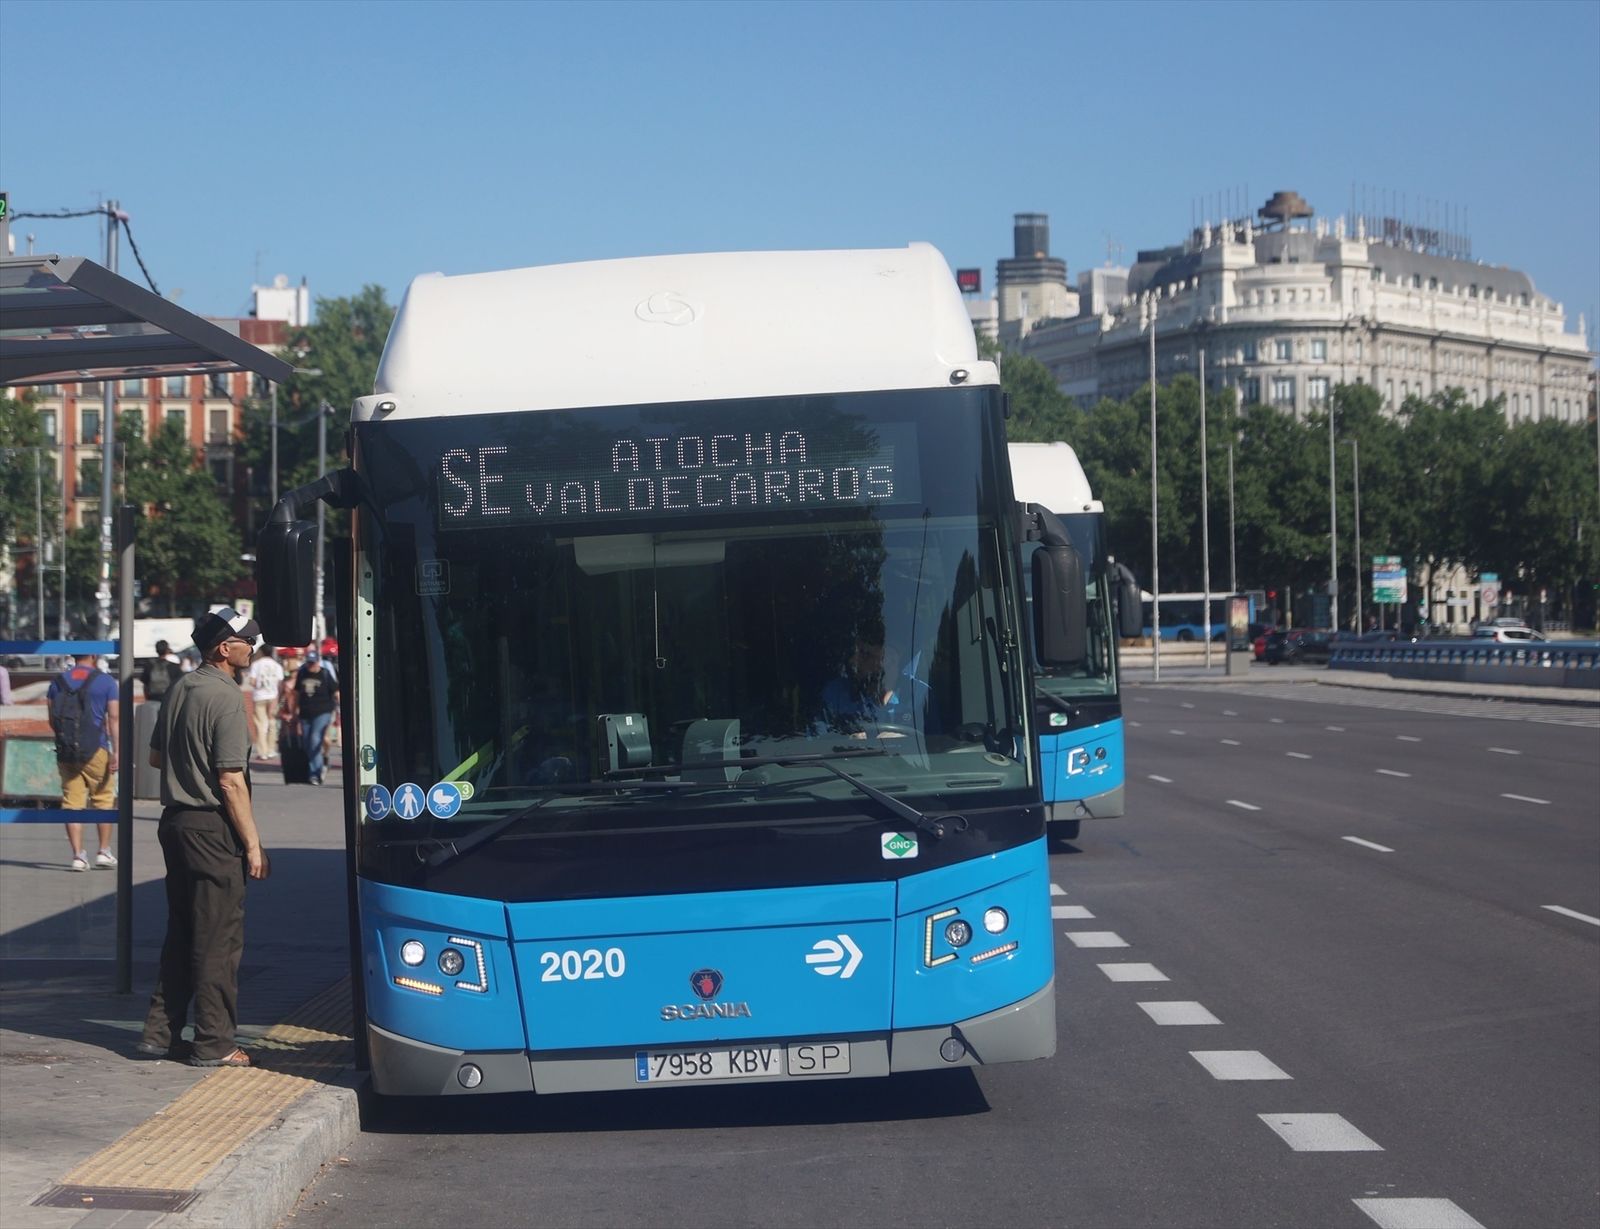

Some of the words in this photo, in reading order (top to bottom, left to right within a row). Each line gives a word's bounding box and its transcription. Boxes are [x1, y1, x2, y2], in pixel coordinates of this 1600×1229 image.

[611, 430, 807, 473] ATOCHA
[441, 446, 511, 516] SE
[526, 465, 894, 515] VALDECARROS
[462, 784, 469, 794] 3
[889, 841, 910, 849] GNC
[540, 947, 626, 982] 2020
[660, 1001, 753, 1022] SCANIA
[654, 1052, 714, 1078] 7958
[728, 1048, 772, 1074] KBV
[797, 1045, 841, 1070] SP
[639, 1069, 647, 1077] E
